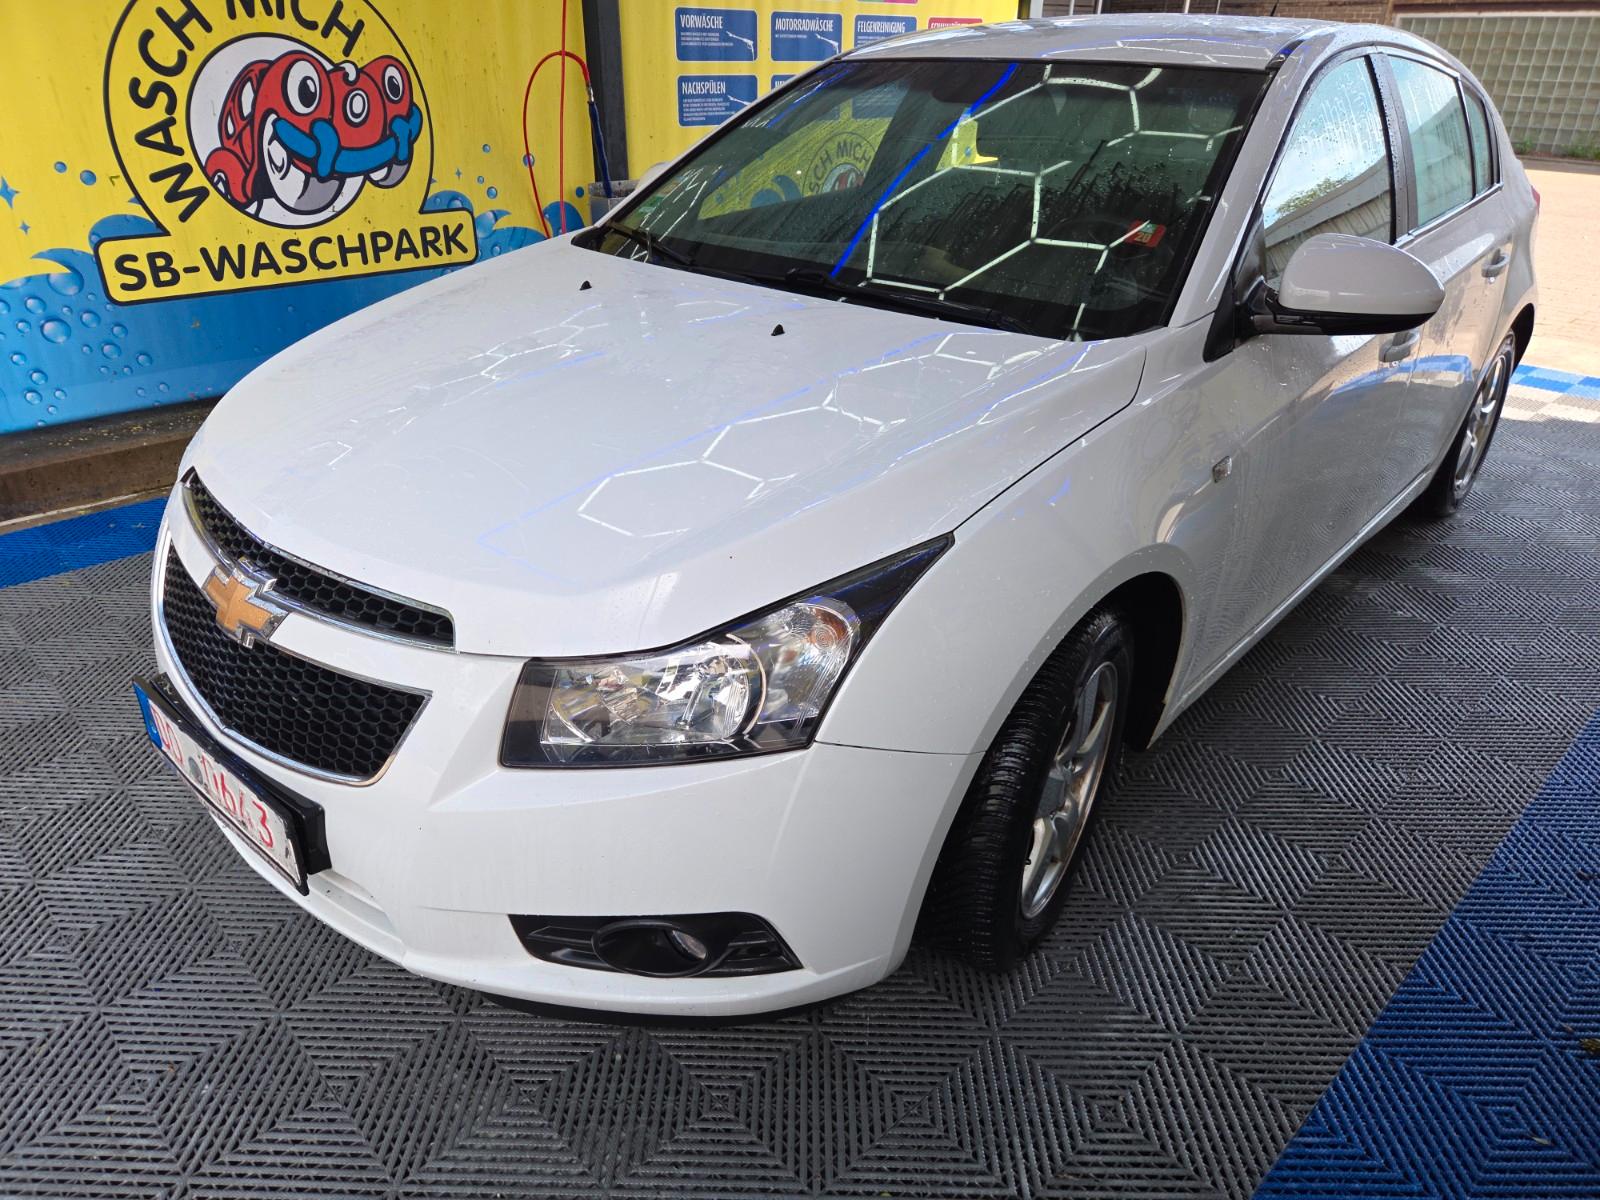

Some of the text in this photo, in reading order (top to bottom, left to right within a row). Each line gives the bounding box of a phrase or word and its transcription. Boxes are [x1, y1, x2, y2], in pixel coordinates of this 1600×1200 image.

[680, 13, 724, 29] VORWÄSCHE
[775, 17, 834, 32] MOTORRADWÄSCHE
[857, 20, 906, 33] FELGENREINIGUNG
[681, 79, 726, 95] NACHSPÜLEN
[114, 222, 469, 292] SB-WASCHPARK
